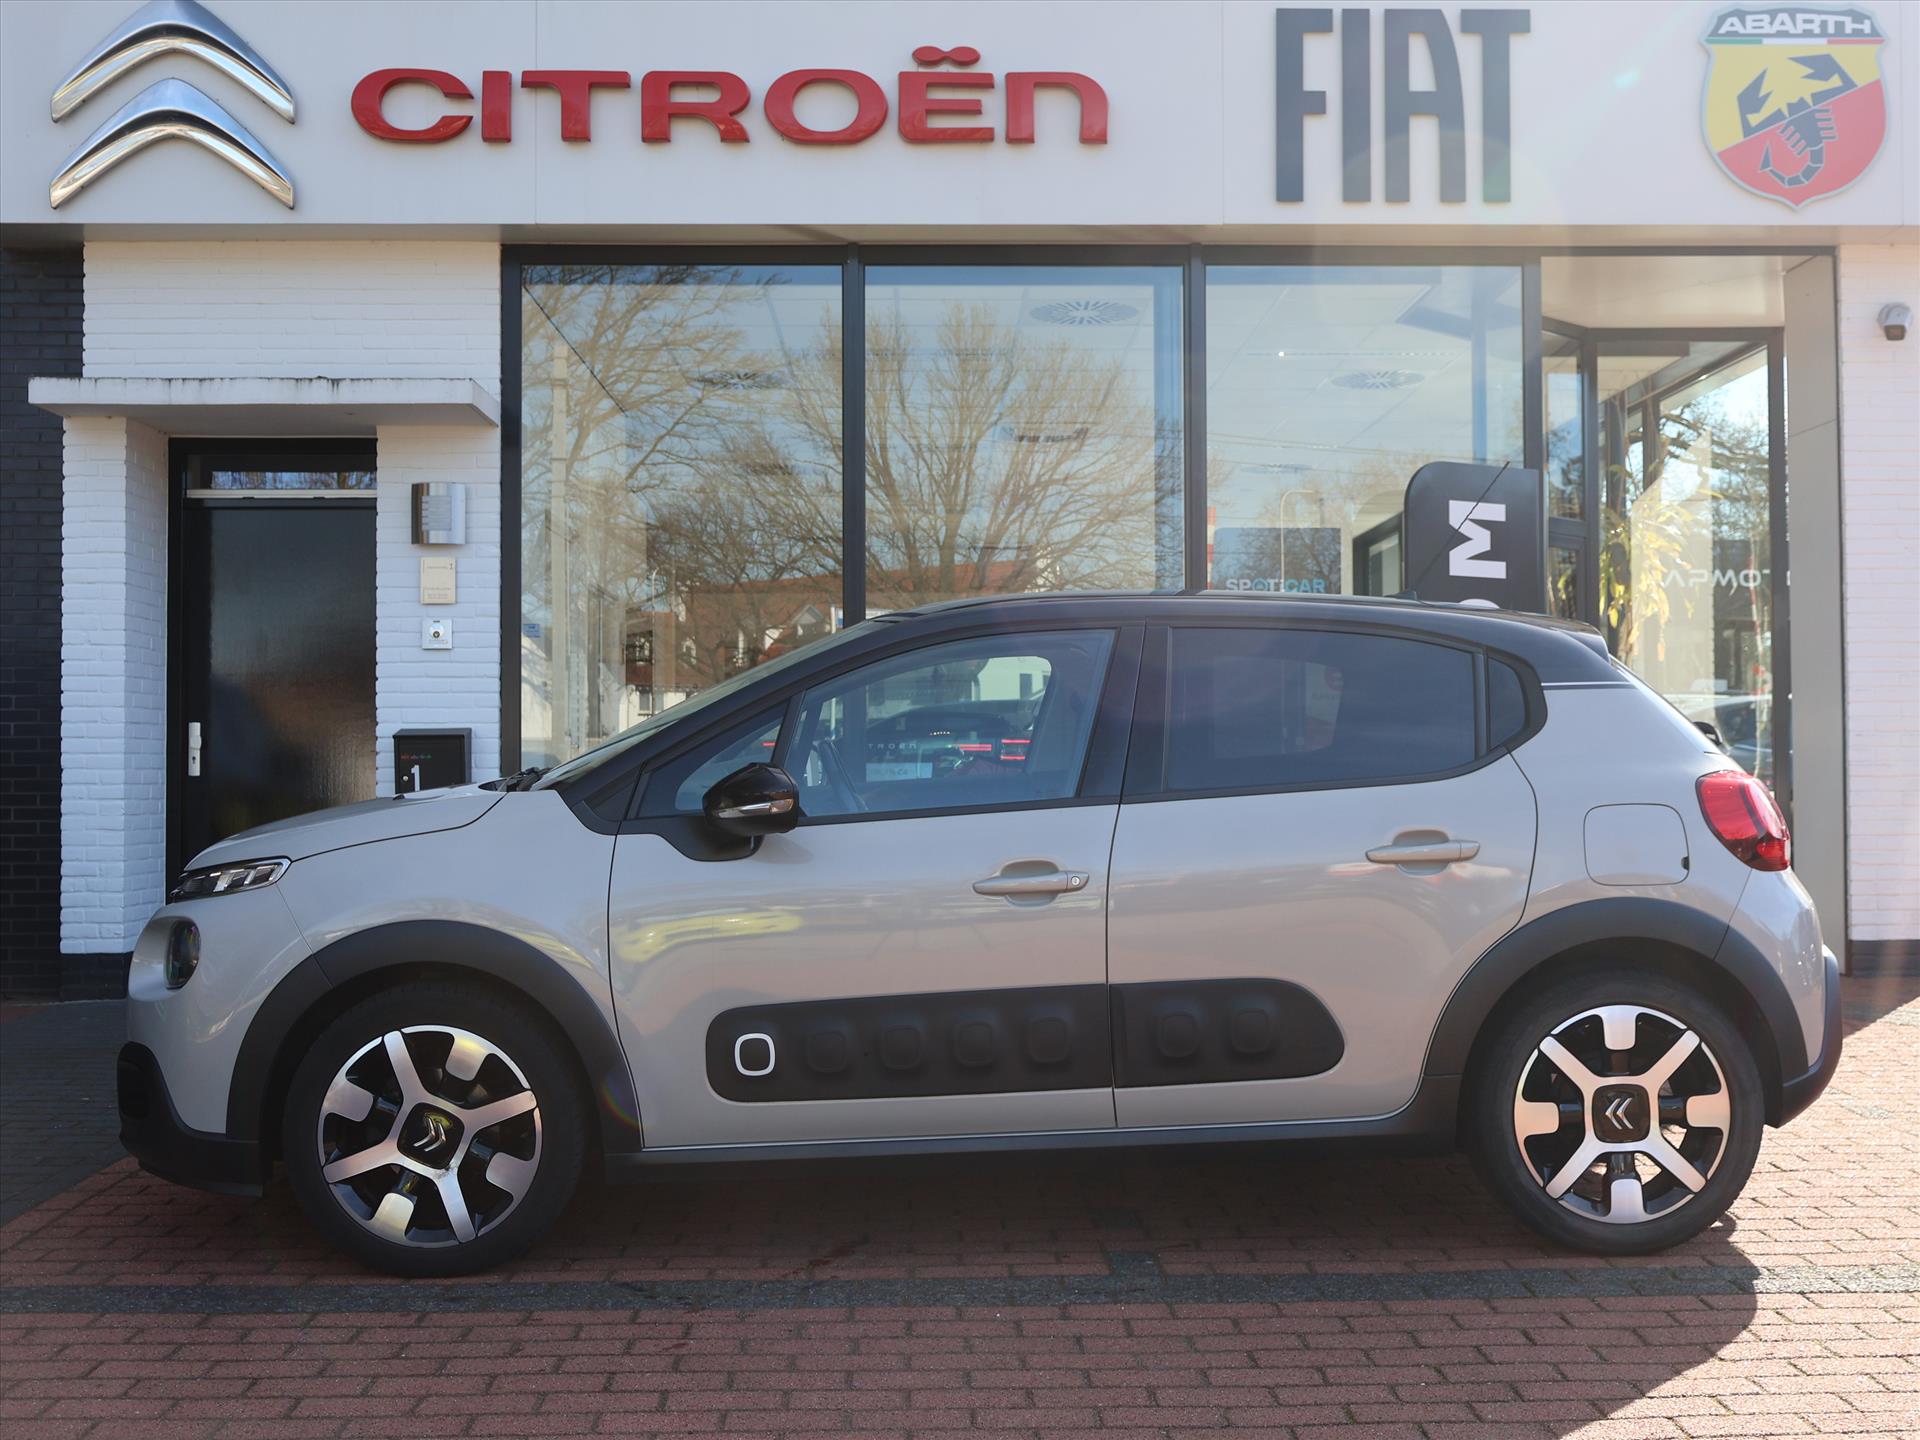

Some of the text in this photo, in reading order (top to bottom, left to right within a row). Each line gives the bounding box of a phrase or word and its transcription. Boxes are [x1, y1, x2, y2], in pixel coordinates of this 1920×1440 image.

[1717, 13, 1871, 34] ABARTH
[351, 45, 1108, 144] CITROËN
[1276, 8, 1531, 203] FIAT
